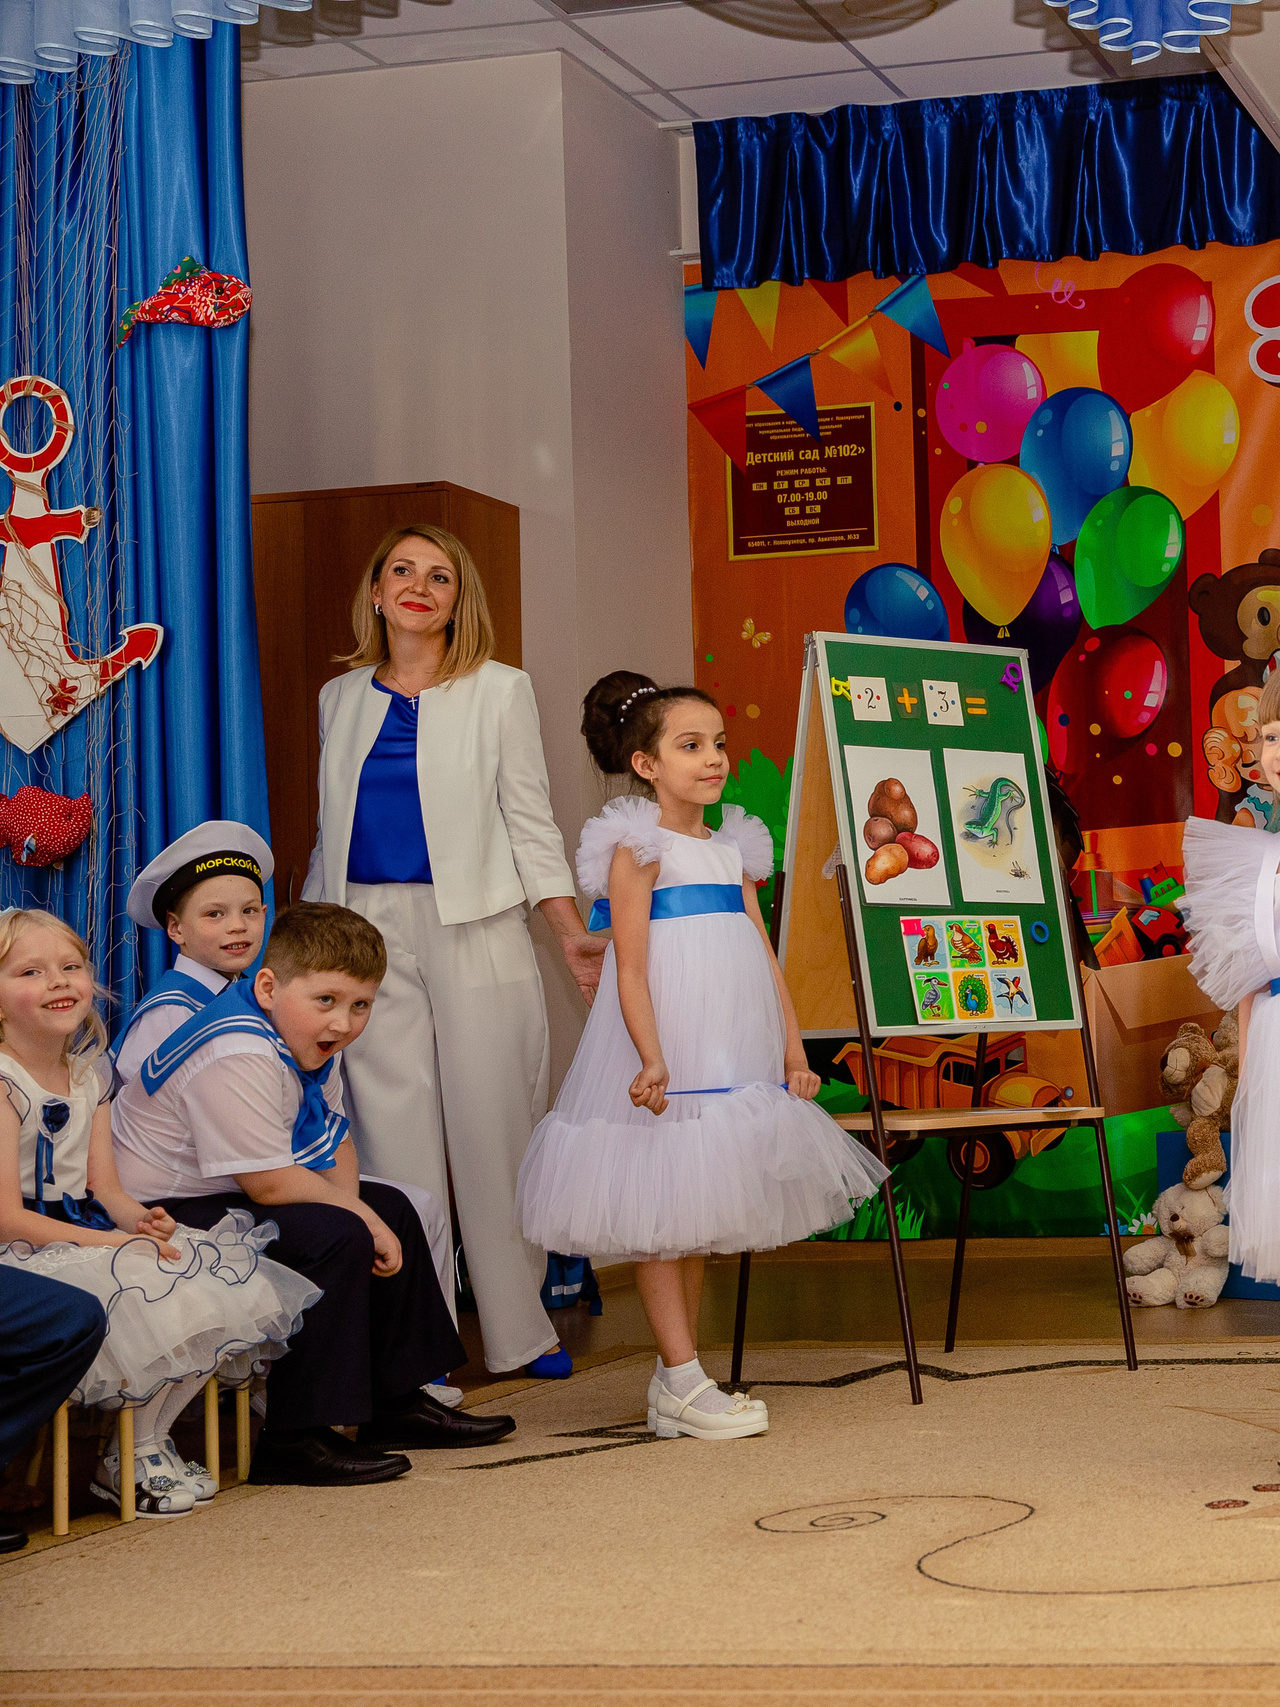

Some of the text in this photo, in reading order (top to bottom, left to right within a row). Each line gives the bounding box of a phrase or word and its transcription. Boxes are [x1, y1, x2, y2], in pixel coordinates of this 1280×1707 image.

[746, 444, 865, 466] Детский сад №102»
[800, 466, 828, 475] РАБОТЫ:
[777, 491, 828, 504] 07.00-19.00
[786, 518, 820, 526] ВЫХОДНОЙ
[864, 687, 876, 709] 2
[937, 690, 949, 713] 3
[196, 857, 252, 874] МОРСКОЙ
